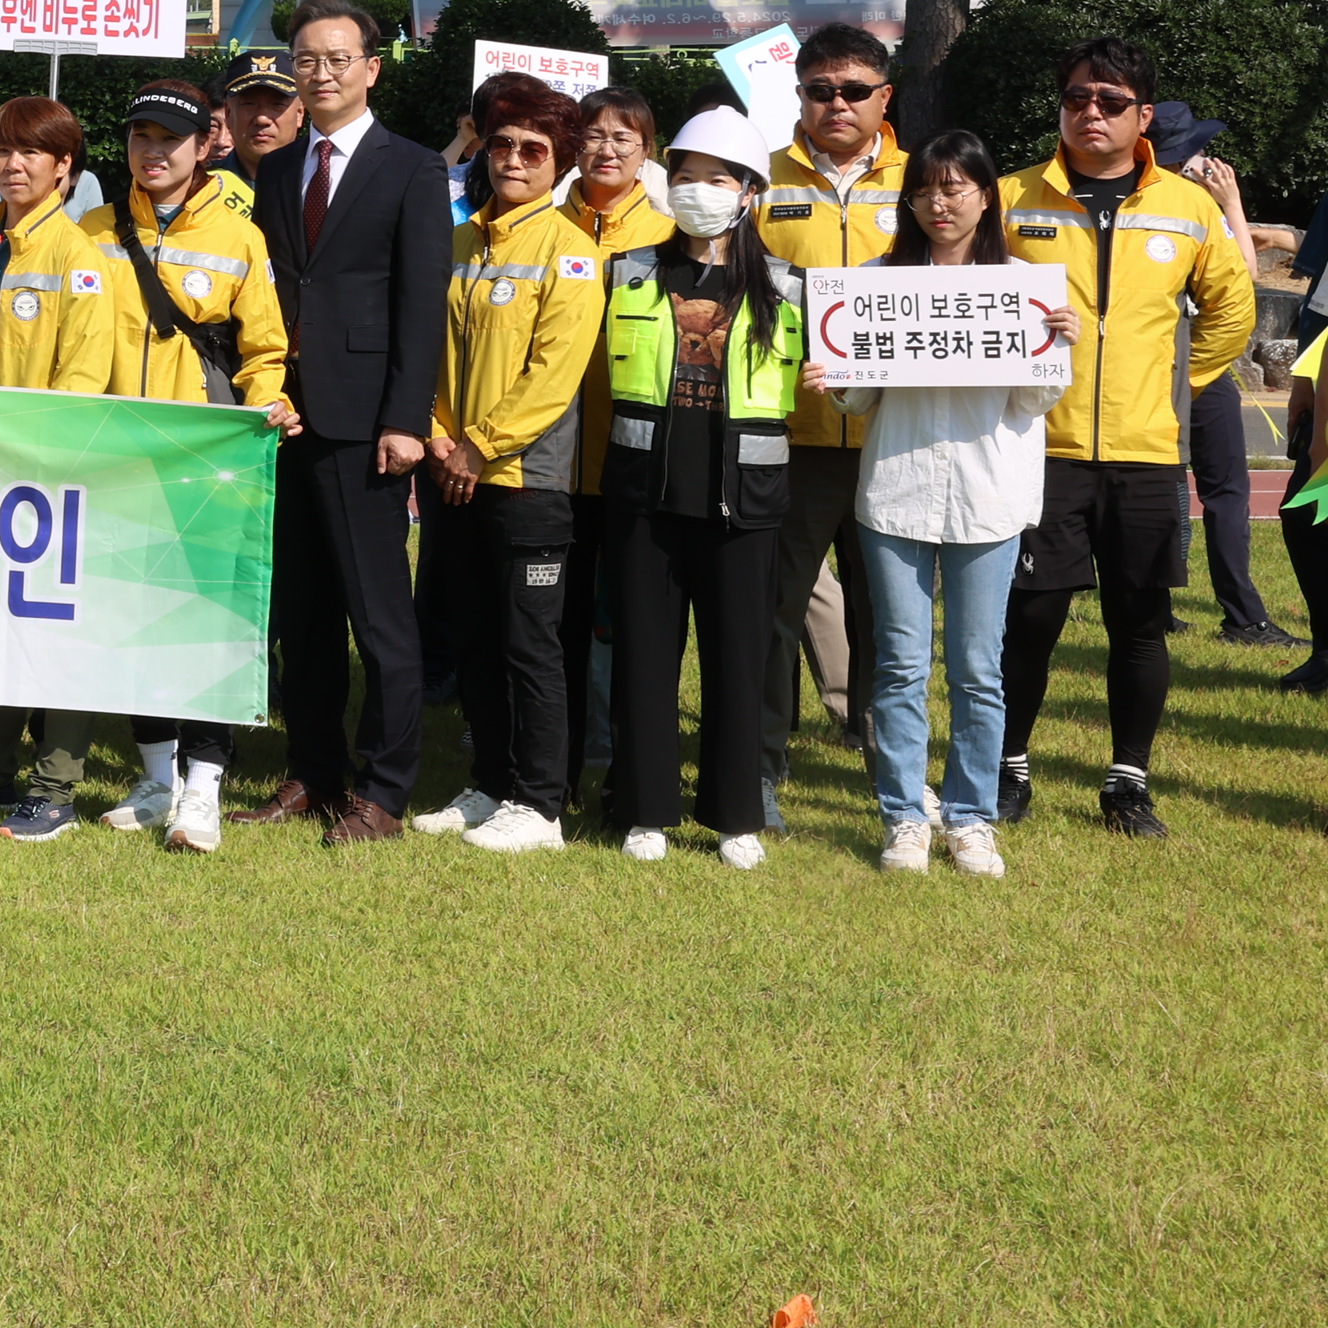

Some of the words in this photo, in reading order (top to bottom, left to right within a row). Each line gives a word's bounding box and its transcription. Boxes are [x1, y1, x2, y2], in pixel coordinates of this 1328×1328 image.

[485, 50, 532, 73] 어린이
[538, 56, 600, 80] 보호구역
[812, 279, 844, 295] 안전
[853, 292, 920, 322] 어린이
[929, 291, 1021, 321] 보호구역
[852, 330, 895, 360] 불법
[904, 329, 973, 360] 주정차
[981, 329, 1027, 359] 금지
[855, 370, 888, 380] 진도군
[1032, 363, 1065, 380] 하자
